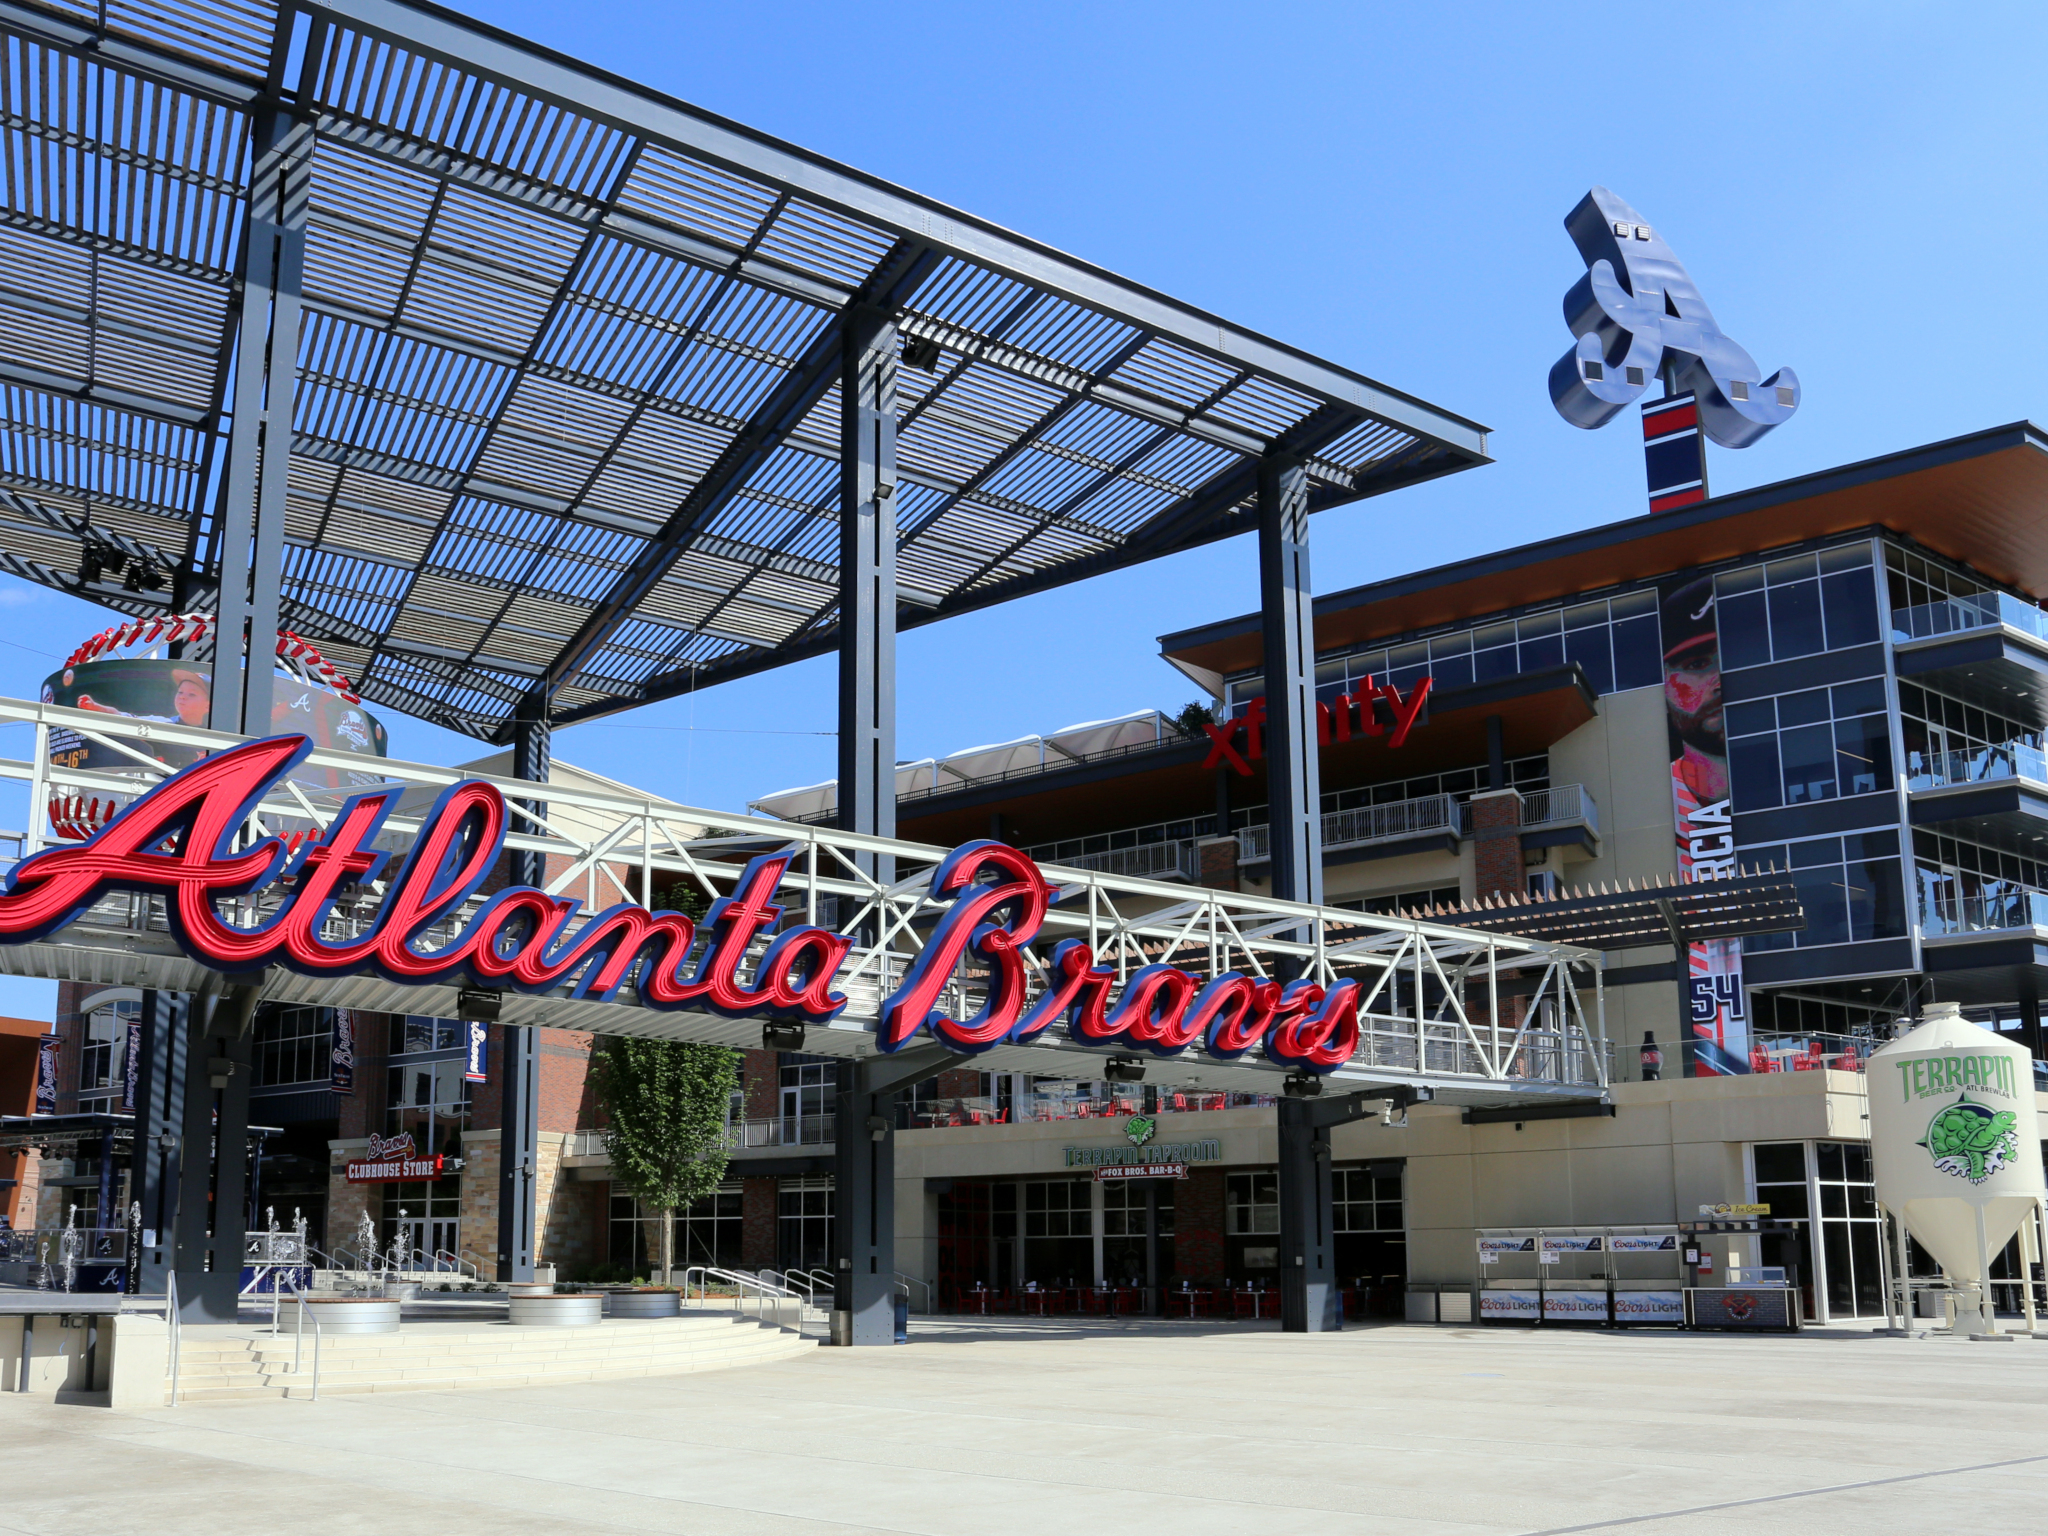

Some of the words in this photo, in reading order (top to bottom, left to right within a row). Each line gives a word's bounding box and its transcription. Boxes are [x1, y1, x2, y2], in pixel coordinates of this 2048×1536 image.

[0, 732, 853, 1022] Atlanta
[876, 839, 1361, 1073] Braves
[1690, 972, 1744, 1022] 54
[1896, 1055, 2018, 1104] TERRAPIN
[1919, 1087, 1943, 1099] BEER
[1966, 1084, 1978, 1092] ATL
[1980, 1085, 2011, 1099] BREWLAB
[366, 1132, 409, 1161] Braves
[1062, 1147, 1140, 1167] TERRAPIN
[1143, 1139, 1221, 1163] TAPROOM
[348, 1162, 401, 1178] CLUBHOUSE
[403, 1160, 435, 1177] STORE
[1108, 1168, 1123, 1177] FOX
[1124, 1167, 1148, 1176] BROS.
[1149, 1165, 1182, 1175] BAR-B-Q
[1735, 1205, 1745, 1213] Ice
[1745, 1205, 1769, 1213] Cream
[1481, 1241, 1501, 1249] Coors
[1544, 1240, 1566, 1249] Coors
[1613, 1239, 1637, 1248] Coors
[1480, 1298, 1512, 1310] Coors
[1512, 1302, 1541, 1311] LIGHT
[1543, 1299, 1577, 1312] Coors
[1578, 1303, 1609, 1312] LIGHT
[1614, 1300, 1651, 1313] Coors
